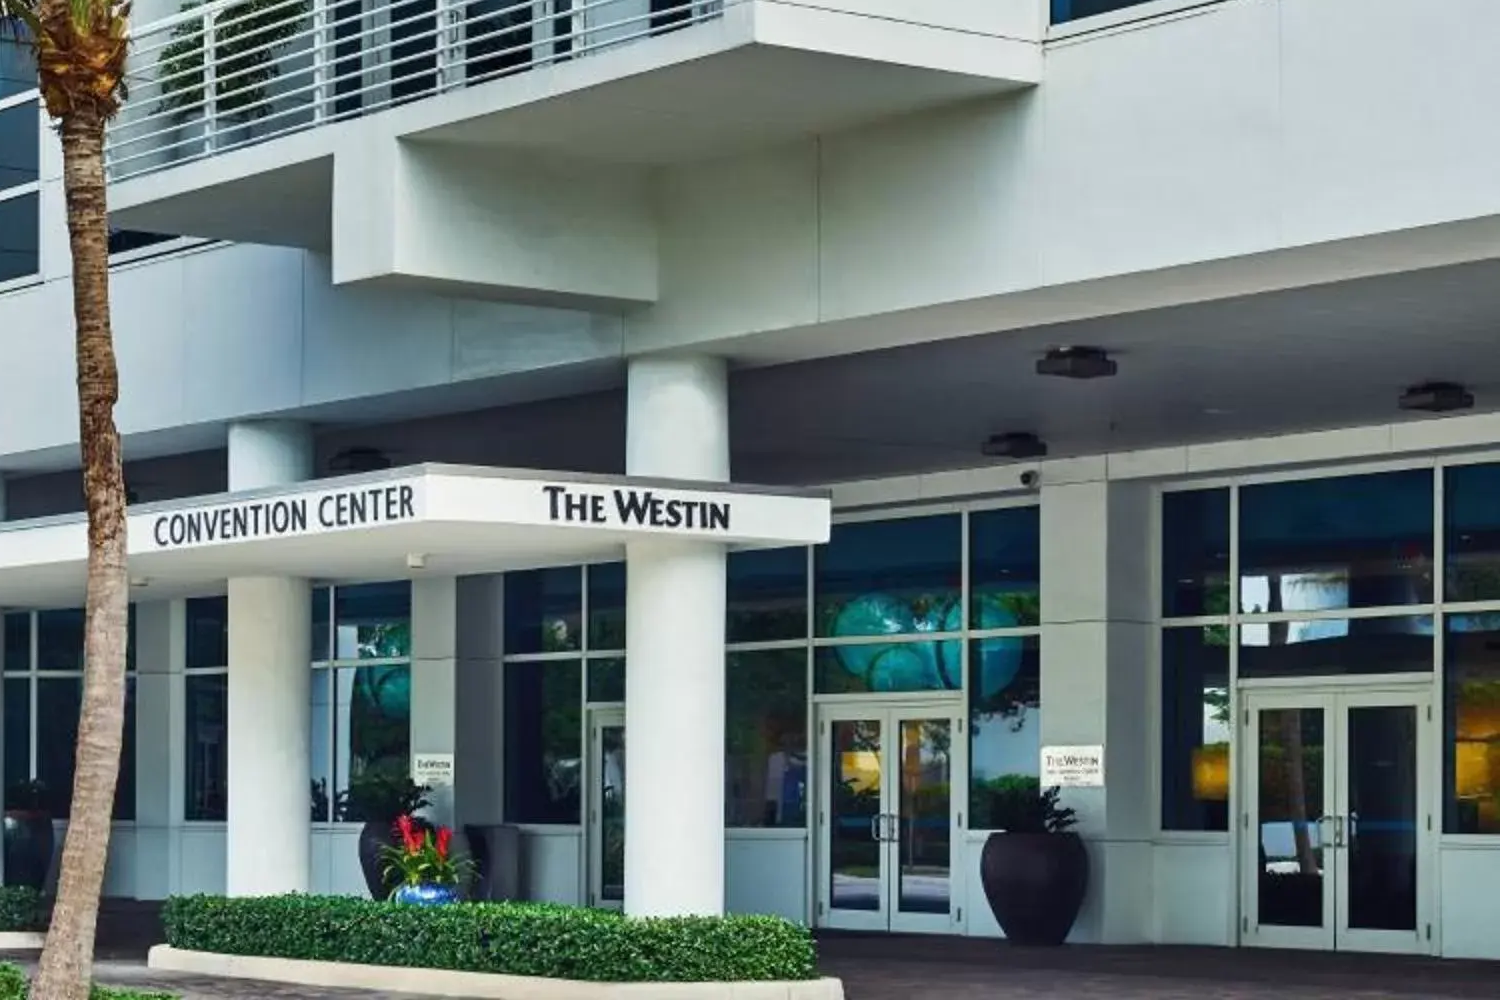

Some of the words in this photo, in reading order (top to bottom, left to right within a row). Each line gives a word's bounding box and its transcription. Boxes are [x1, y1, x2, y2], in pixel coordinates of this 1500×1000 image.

[154, 499, 307, 546] CONVENTION
[319, 485, 415, 528] CENTER
[543, 486, 607, 523] THE
[613, 489, 731, 530] WESTIN
